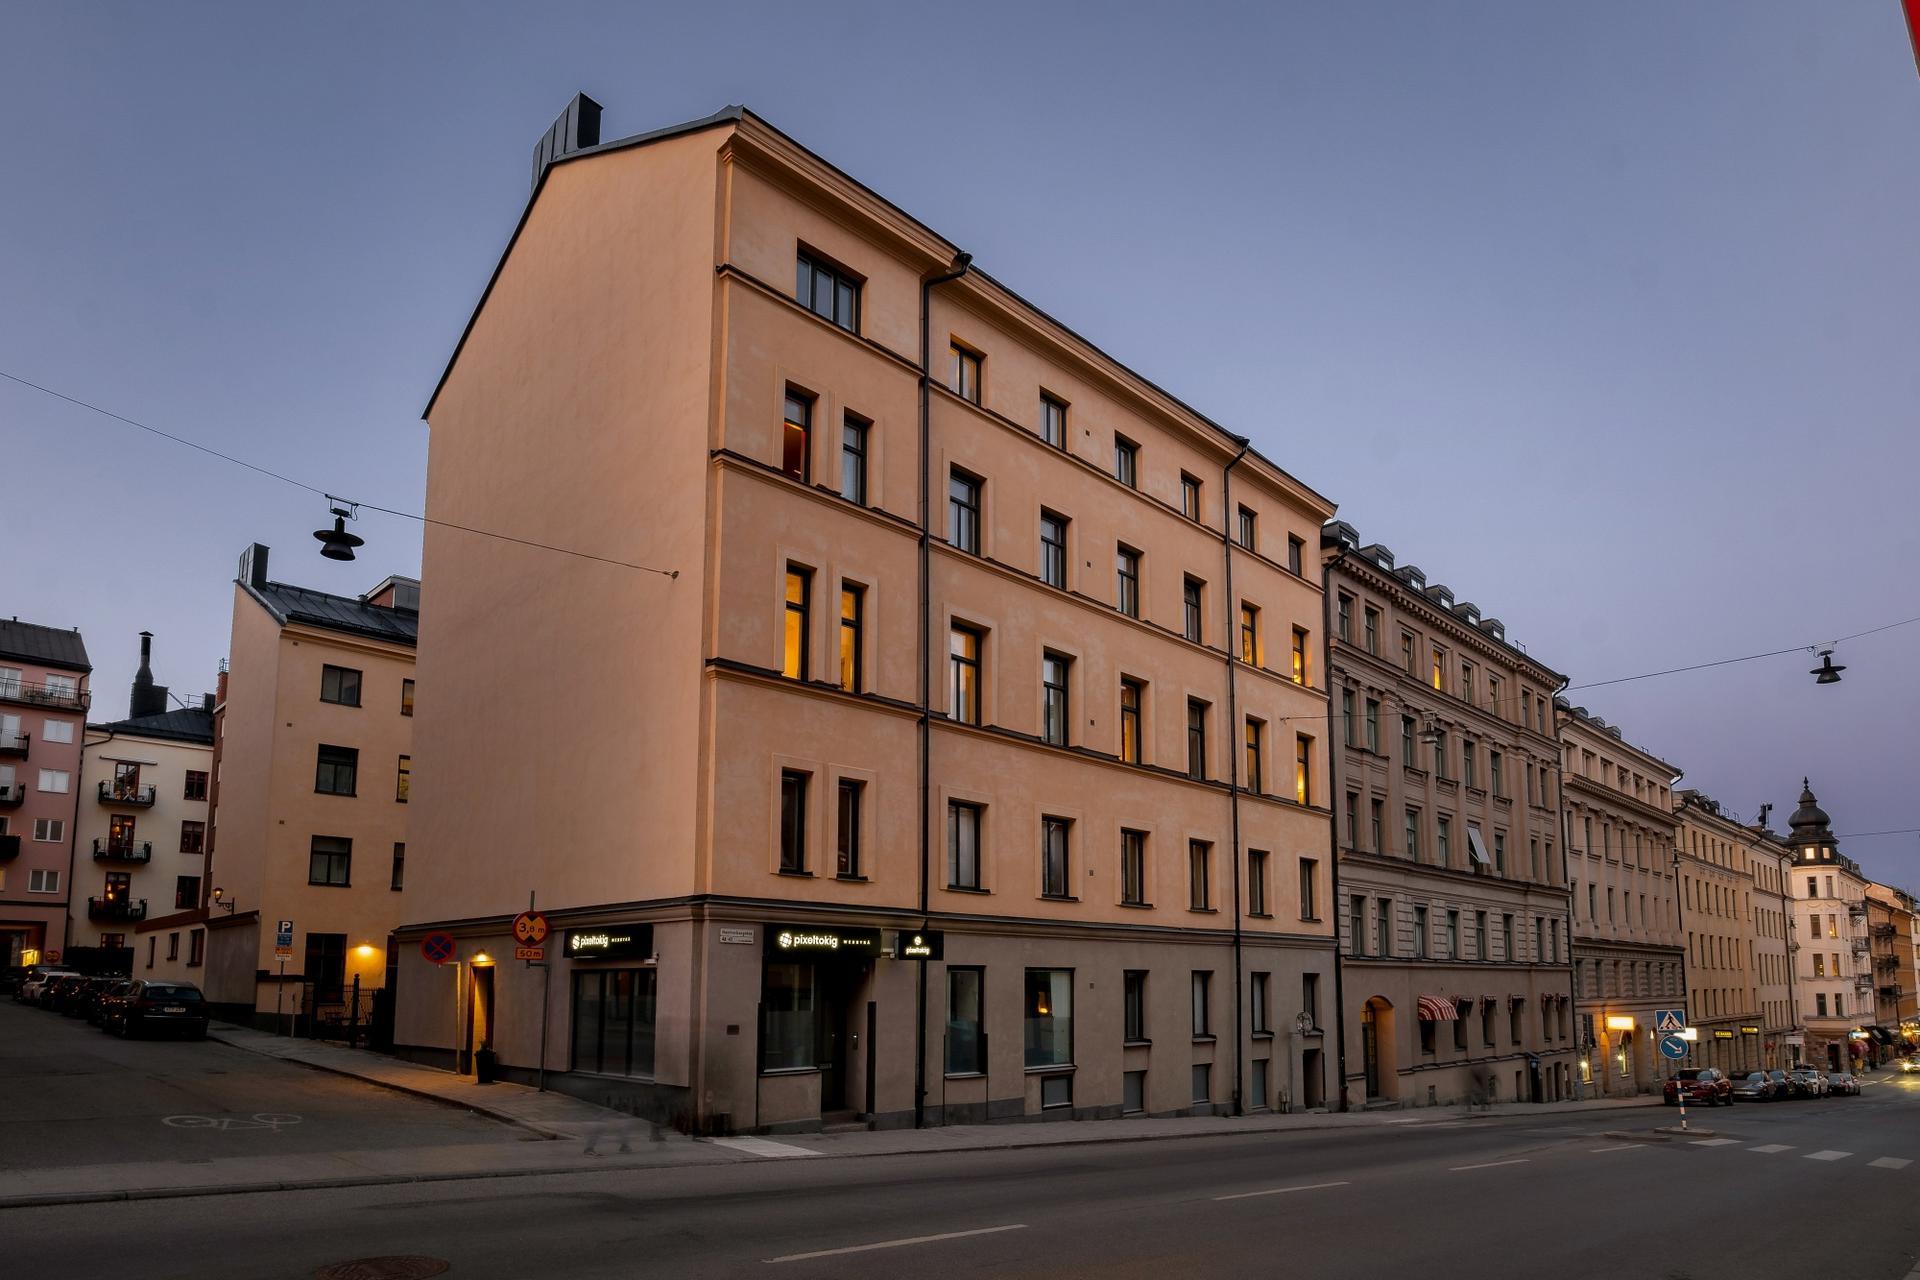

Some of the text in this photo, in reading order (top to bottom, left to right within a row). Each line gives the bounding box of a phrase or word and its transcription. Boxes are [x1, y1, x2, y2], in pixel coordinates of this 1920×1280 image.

[282, 921, 291, 932] P
[519, 922, 535, 934] 3,8
[580, 934, 608, 948] pixeltokig
[794, 934, 838, 949] pixeltokig
